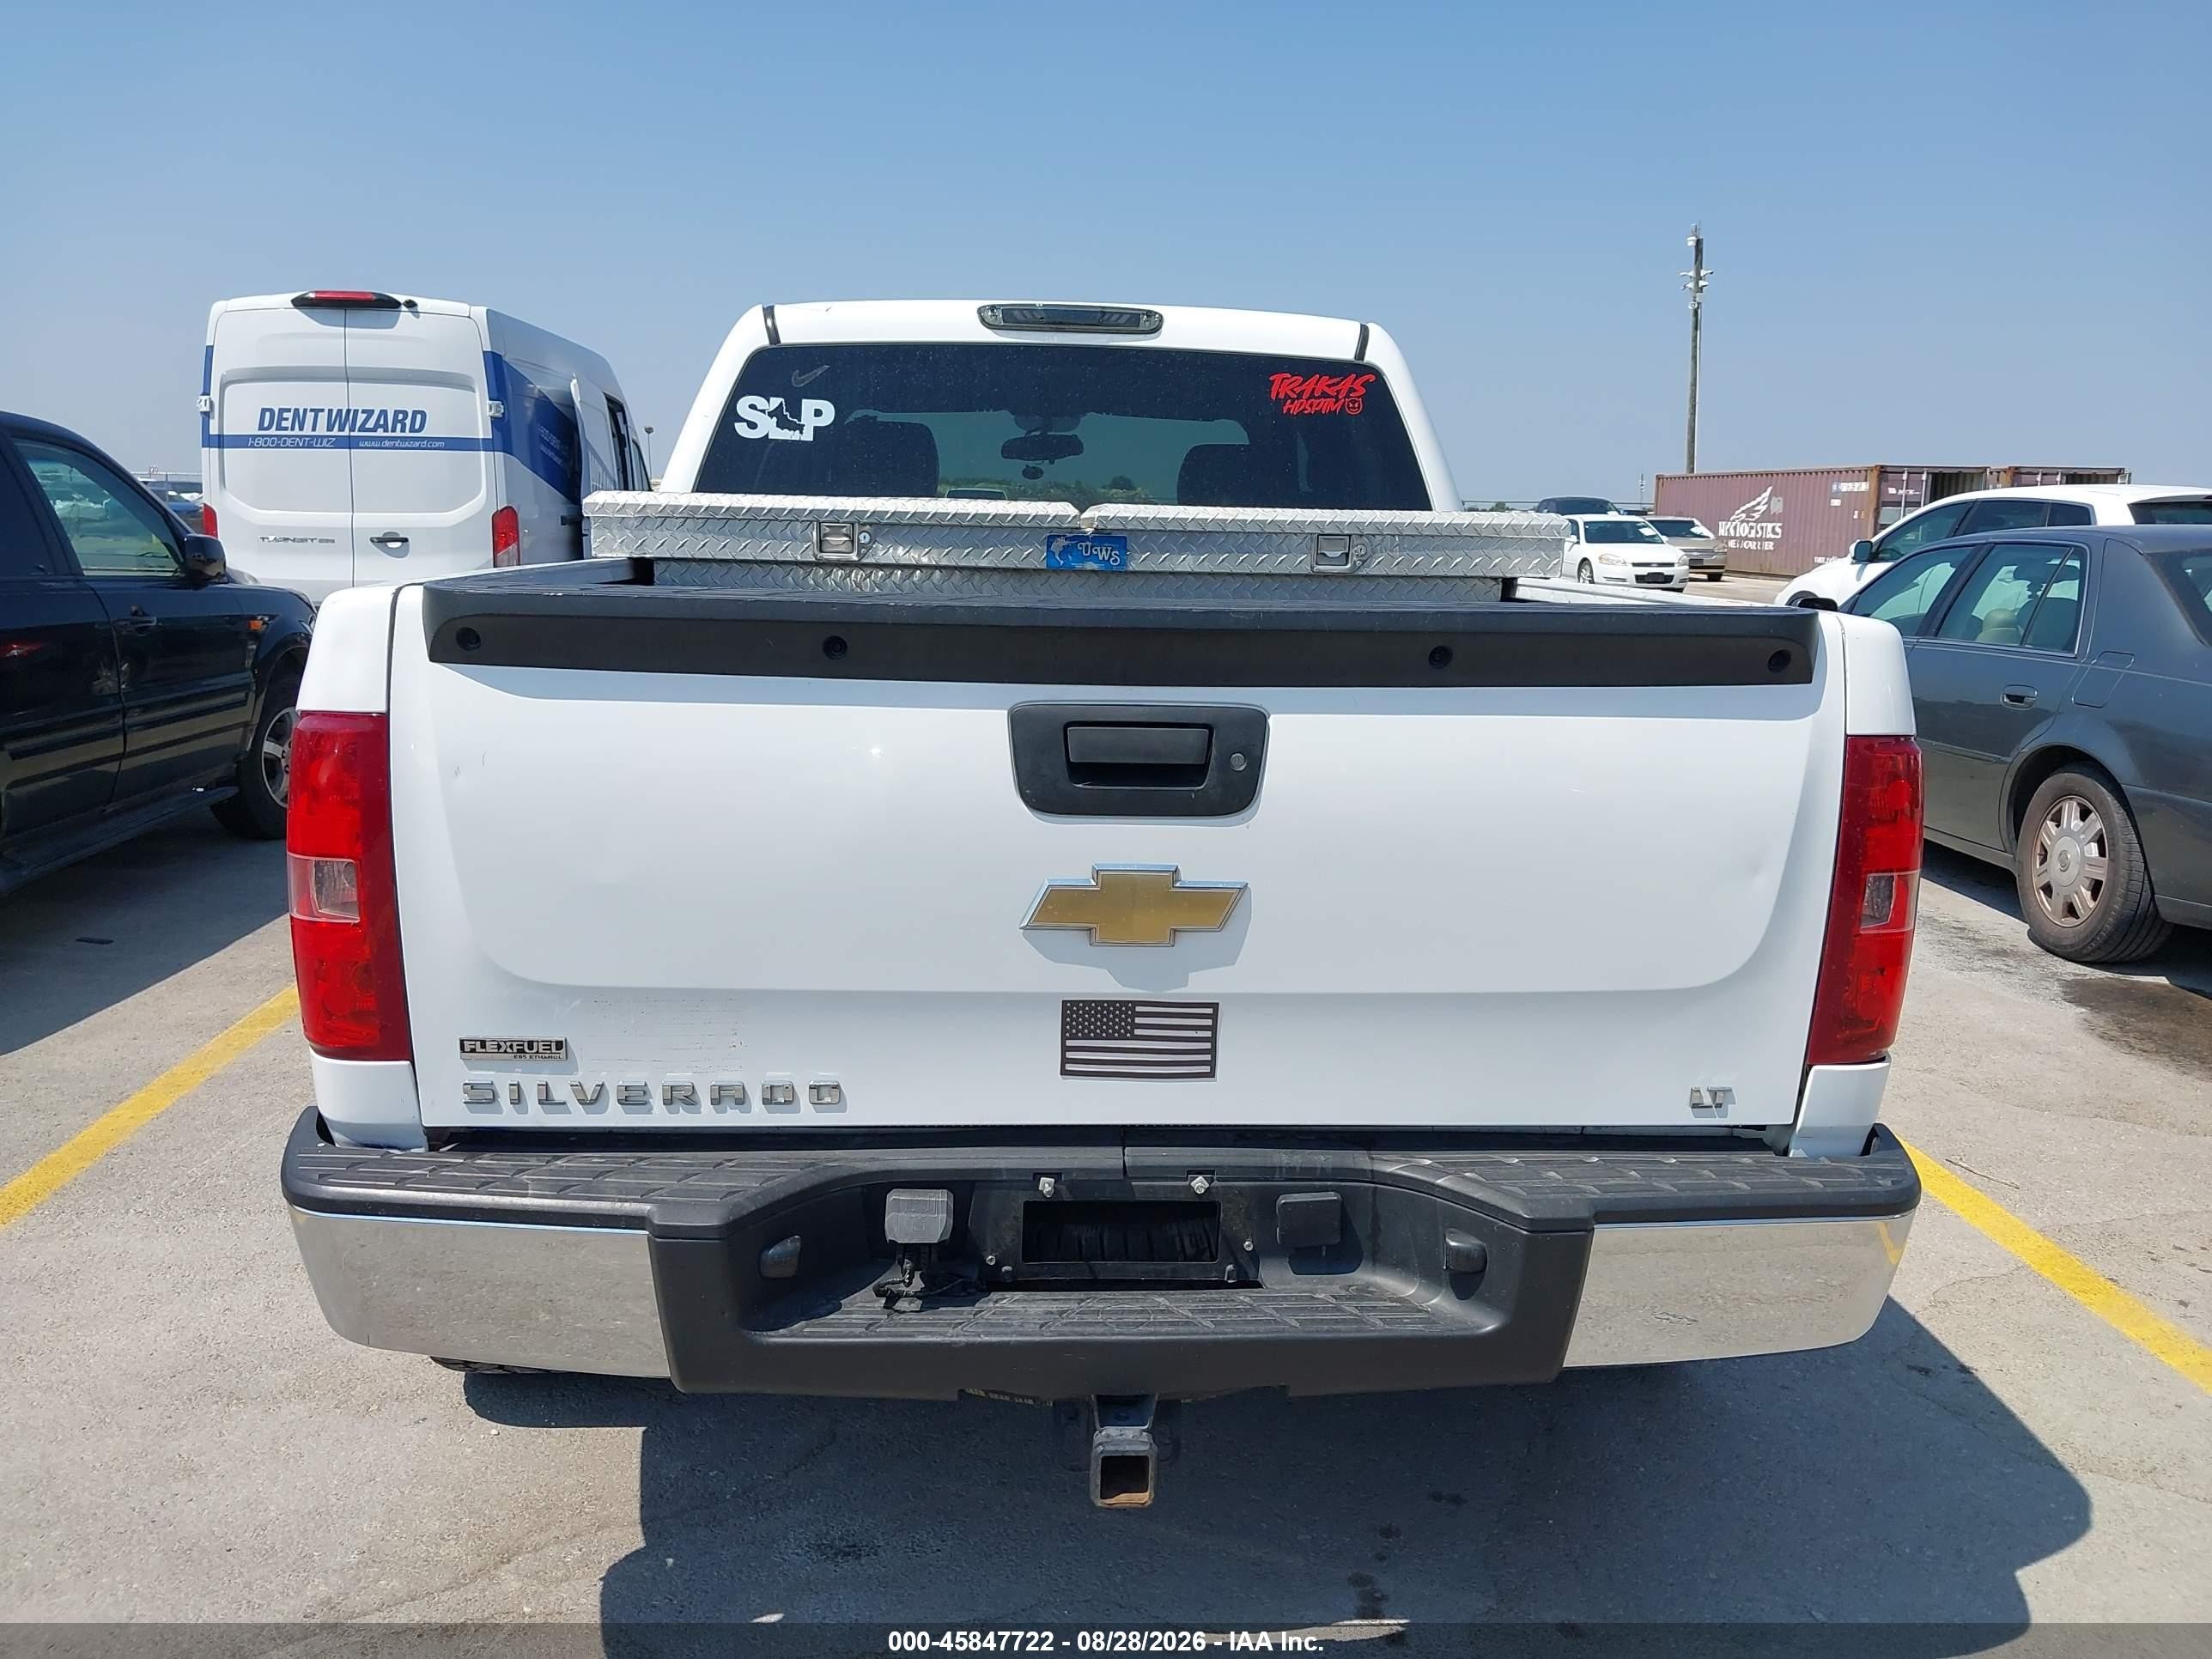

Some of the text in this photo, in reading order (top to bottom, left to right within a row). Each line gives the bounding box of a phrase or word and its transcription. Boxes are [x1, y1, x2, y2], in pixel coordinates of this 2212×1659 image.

[1269, 374, 1376, 399] TRAKAS
[258, 408, 428, 434] DENT WIZARD
[734, 395, 836, 441] SLP
[247, 437, 337, 447] 1-800-DENT-WIZ
[359, 439, 445, 448] www.dentwizard.com
[1077, 541, 1121, 566] UWS
[464, 1040, 564, 1054] FLEXFUEL
[462, 1079, 842, 1106] SILVERADO
[1690, 1085, 1733, 1109] LT
